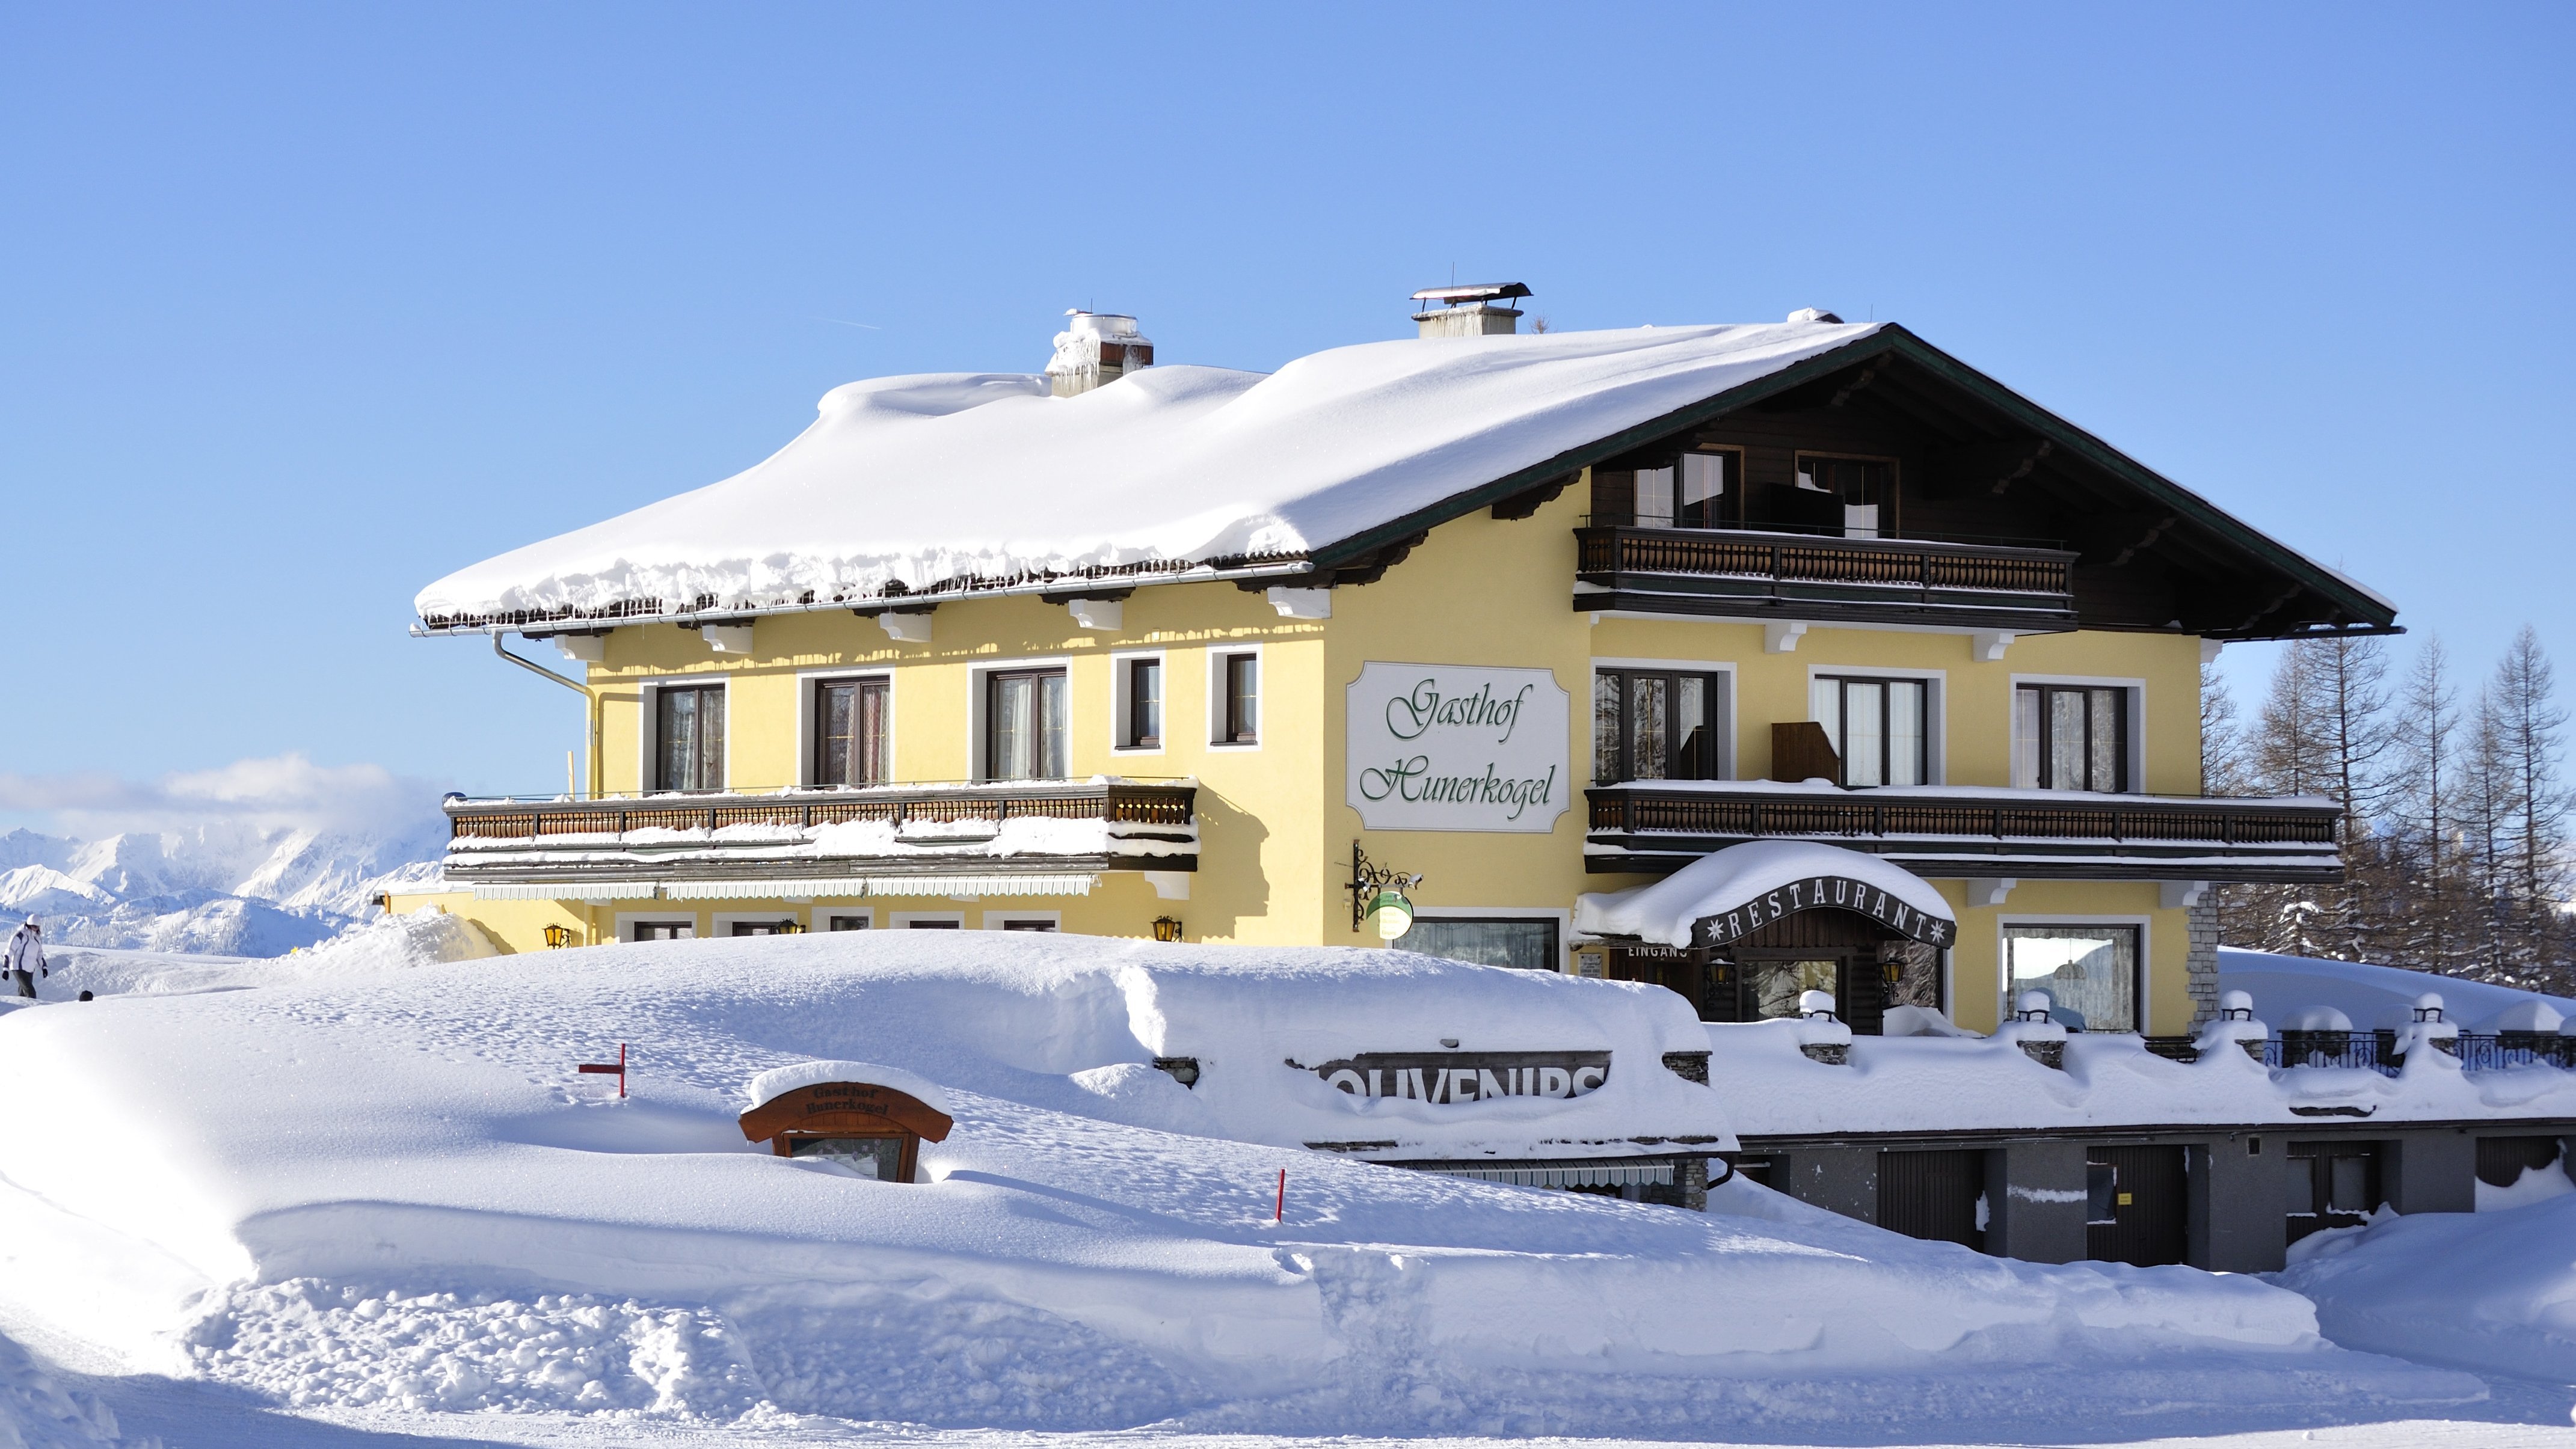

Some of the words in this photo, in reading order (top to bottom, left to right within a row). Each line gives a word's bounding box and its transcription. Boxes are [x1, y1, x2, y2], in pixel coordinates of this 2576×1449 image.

[1386, 678, 1533, 743] Gasthof
[1359, 755, 1556, 819] Hunerkogel
[1728, 878, 1926, 939] RESTAURANT
[807, 1099, 889, 1115] Hunerkogel
